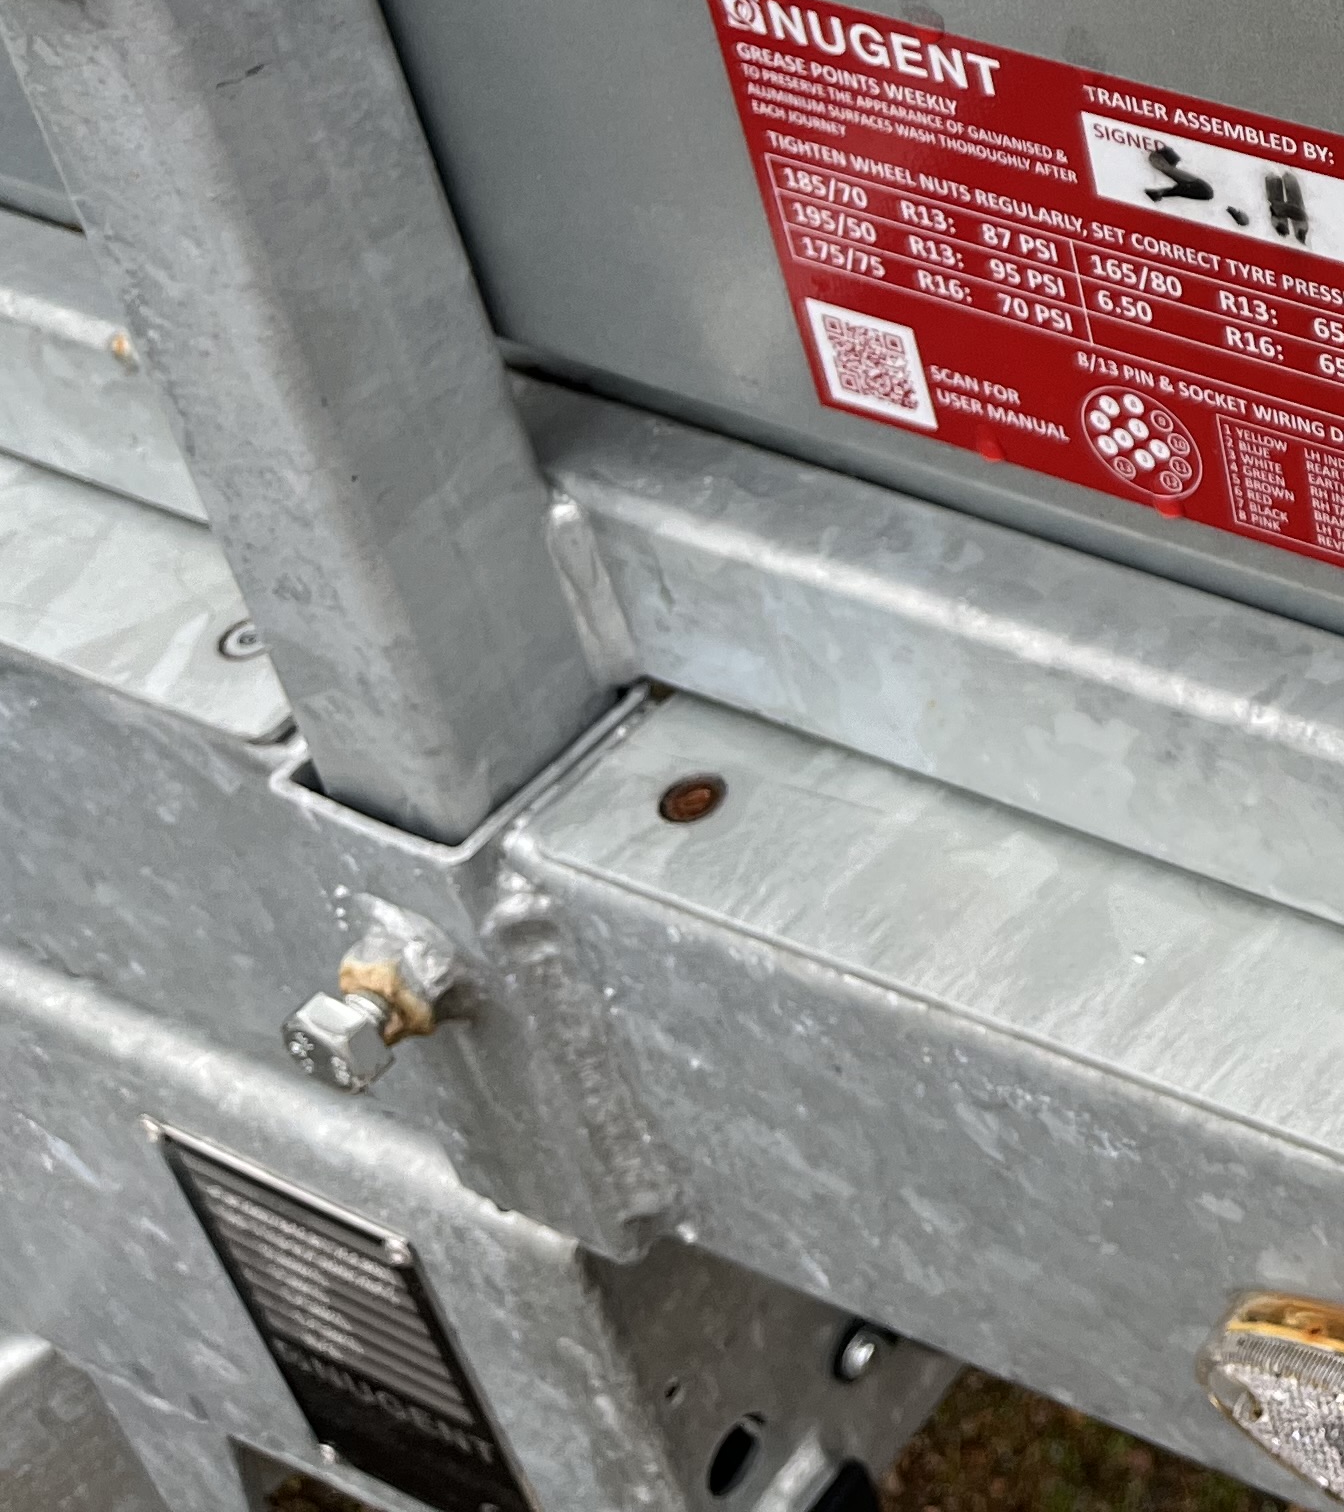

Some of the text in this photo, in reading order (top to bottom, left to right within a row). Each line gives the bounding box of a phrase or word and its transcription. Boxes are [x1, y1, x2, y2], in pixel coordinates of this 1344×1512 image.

[736, 41, 957, 116] GREASE POINTS WEEKLY
[766, 0, 1000, 97] NUGENT
[741, 62, 1068, 164] TO PRESERVE THE APPEARANCE OF GALVANISED &
[748, 81, 1078, 184] ALUMINIUM SURFACES WASH THOROUGHLY AFTER
[752, 99, 847, 137] EACH JOURNEY
[1082, 85, 1336, 166] TRAILER ASSEMBLED BY:
[1093, 123, 1167, 152] SIGNED
[766, 130, 846, 168] TIGHTEN
[850, 151, 916, 187] WHEEL
[920, 174, 971, 203] NUTS
[976, 190, 1088, 237] REGULARLY,
[1093, 221, 1125, 244] SET
[1132, 232, 1220, 272] CORRECT
[1225, 258, 1277, 288] TYRE
[782, 166, 1058, 263] 185/70 R13: 87 PSI
[791, 201, 1066, 298] 195/50 R13: 95 PSI
[801, 235, 1074, 334] 175/75 R16: 70 PSI
[1090, 254, 1183, 299] 165/80
[1218, 289, 1279, 326] R13:
[1313, 317, 1344, 345] 65
[1097, 289, 1153, 323] 6.50
[1224, 326, 1285, 361] R16:
[929, 365, 1020, 405] SCAN FOR
[936, 388, 1070, 443] USER MANUAL
[1123, 364, 1155, 387] PIN
[1160, 376, 1175, 393] &
[1179, 383, 1247, 414] SOCKET
[1252, 402, 1326, 438] WIRING
[1224, 424, 1231, 435] 1
[1236, 427, 1287, 452] YELLOW
[1304, 448, 1320, 462] LH
[1225, 436, 1233, 448] 2
[1239, 440, 1271, 458] BLUE
[1306, 460, 1340, 480] REAR
[1240, 452, 1283, 475] WHITE
[1230, 461, 1238, 472] 4
[1243, 465, 1285, 487] GREEN
[1310, 485, 1328, 500] RH
[1245, 477, 1295, 501] BROWN
[1312, 497, 1330, 513] RH
[1247, 489, 1272, 505] RED
[1236, 497, 1244, 508] 7
[1249, 501, 1289, 523] BLACK
[1316, 522, 1332, 536] LH
[1251, 513, 1281, 532] PINK
